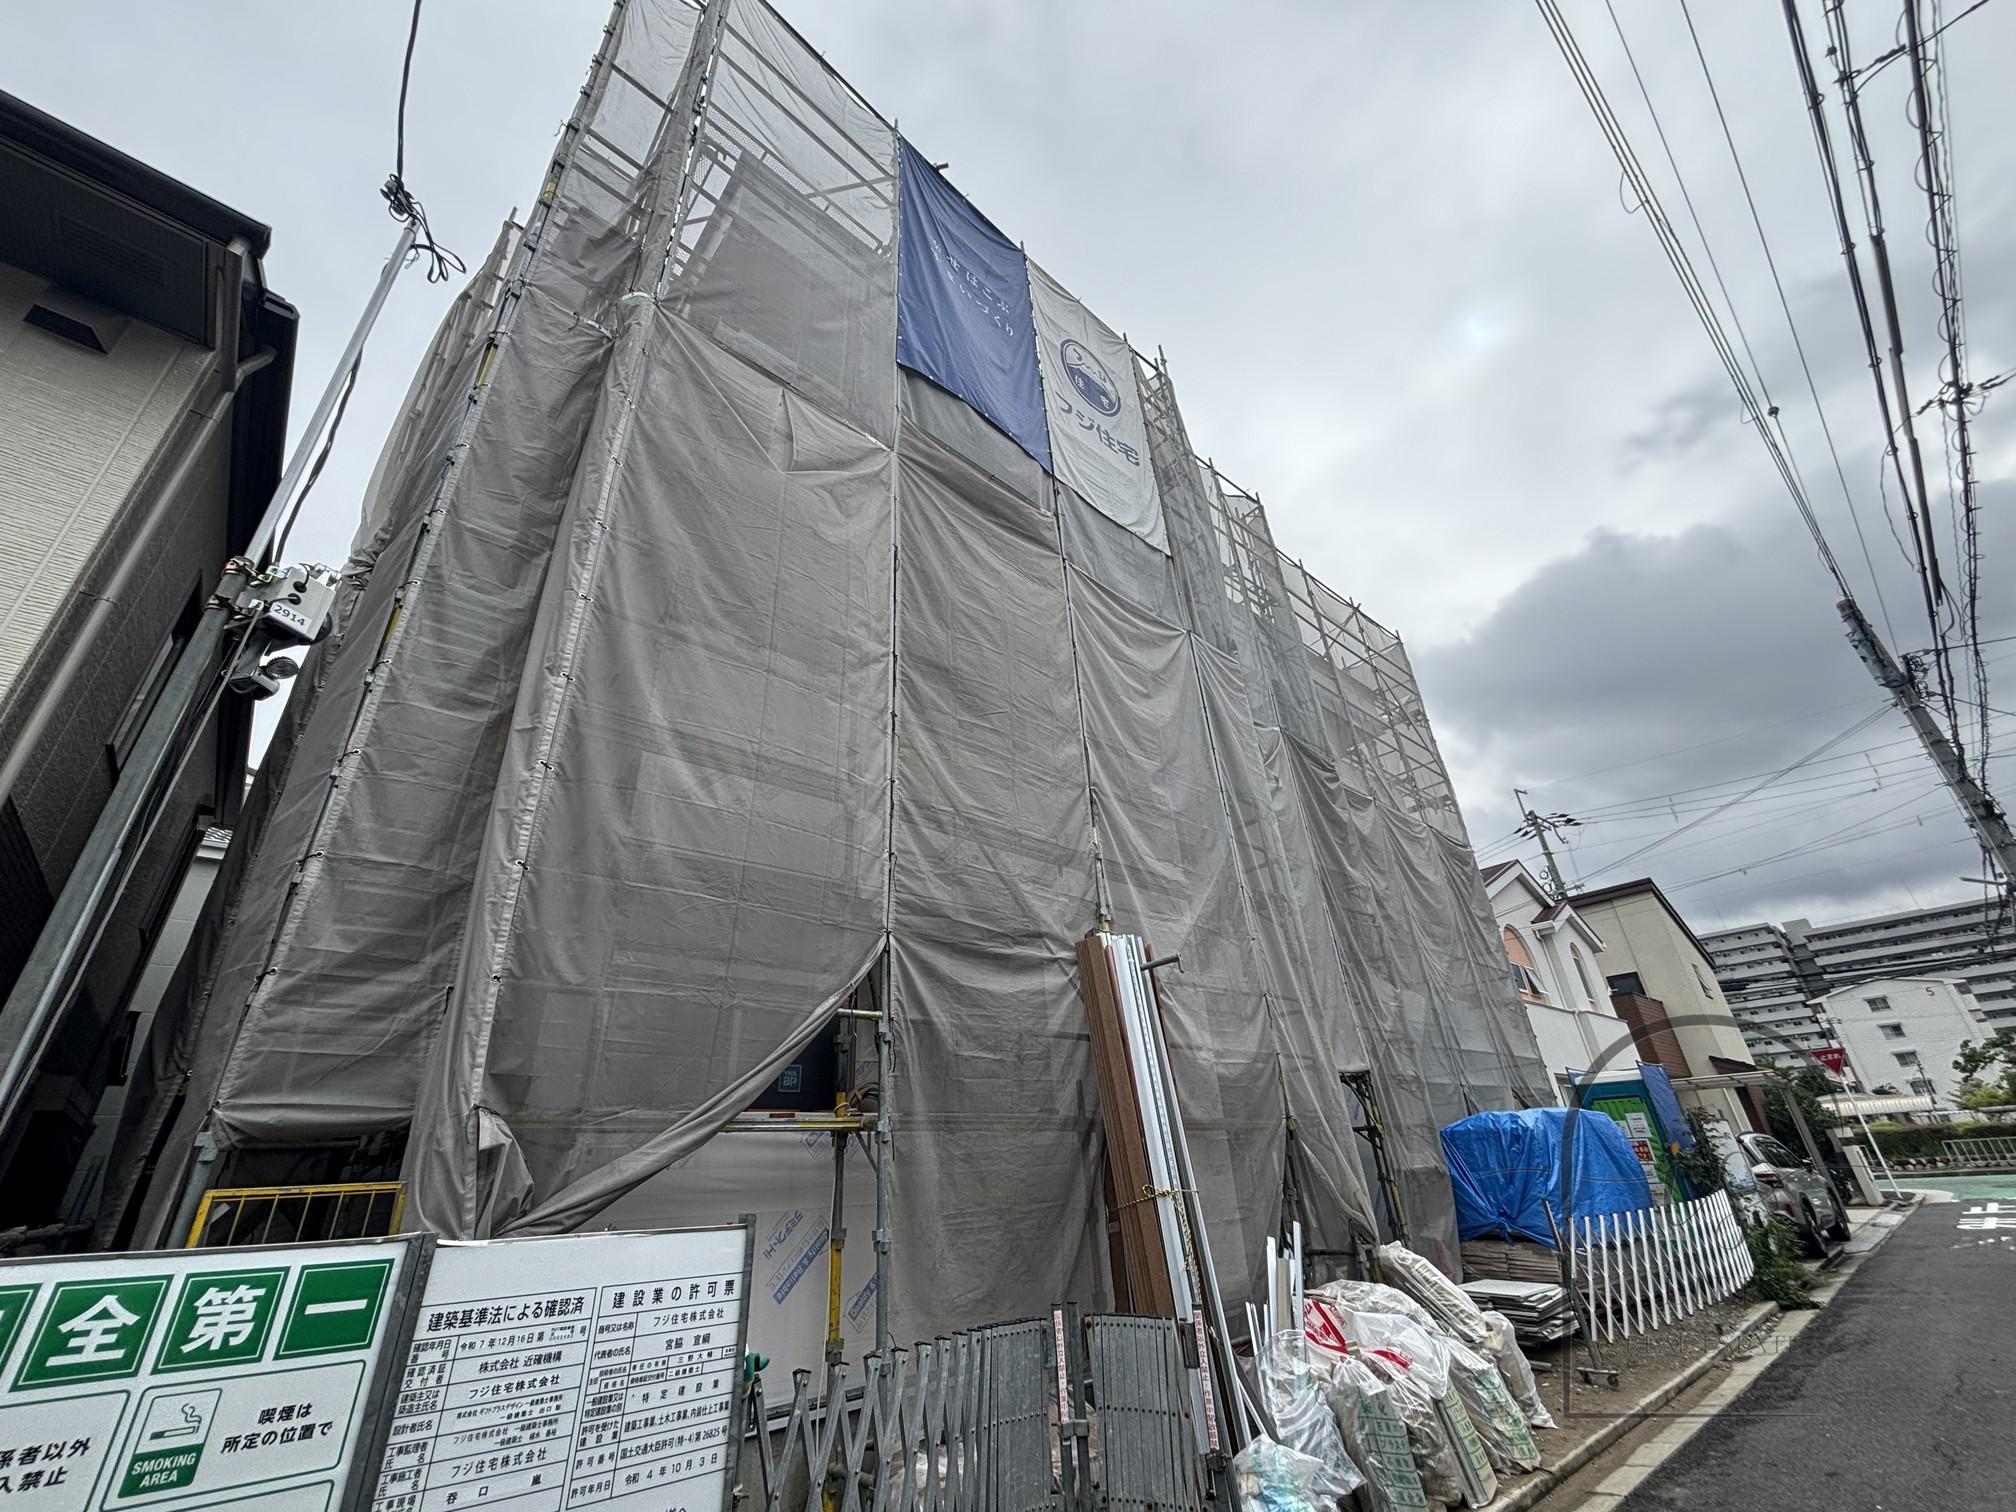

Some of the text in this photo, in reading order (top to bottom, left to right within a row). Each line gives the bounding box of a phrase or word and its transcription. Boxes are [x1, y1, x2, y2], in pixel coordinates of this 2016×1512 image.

[1055, 391, 1140, 466] フジ住宅
[274, 604, 305, 626] 2914
[1925, 986, 1935, 997] 5
[612, 1279, 735, 1310] 建設業の許可票
[427, 1296, 585, 1333] 建築基準法による確認済
[653, 1307, 725, 1327] フジ住宅株式会社
[413, 1339, 452, 1353] 確認年月日
[478, 1357, 519, 1374] 株式会社
[468, 1374, 560, 1399] フジ住宅株式会社
[257, 1403, 312, 1425] 喫煙は
[220, 1422, 333, 1454] 所定の位置で
[132, 1451, 197, 1475] SMOKING
[451, 1447, 547, 1479] フジ住宅株式会社
[139, 1469, 178, 1488] AREA
